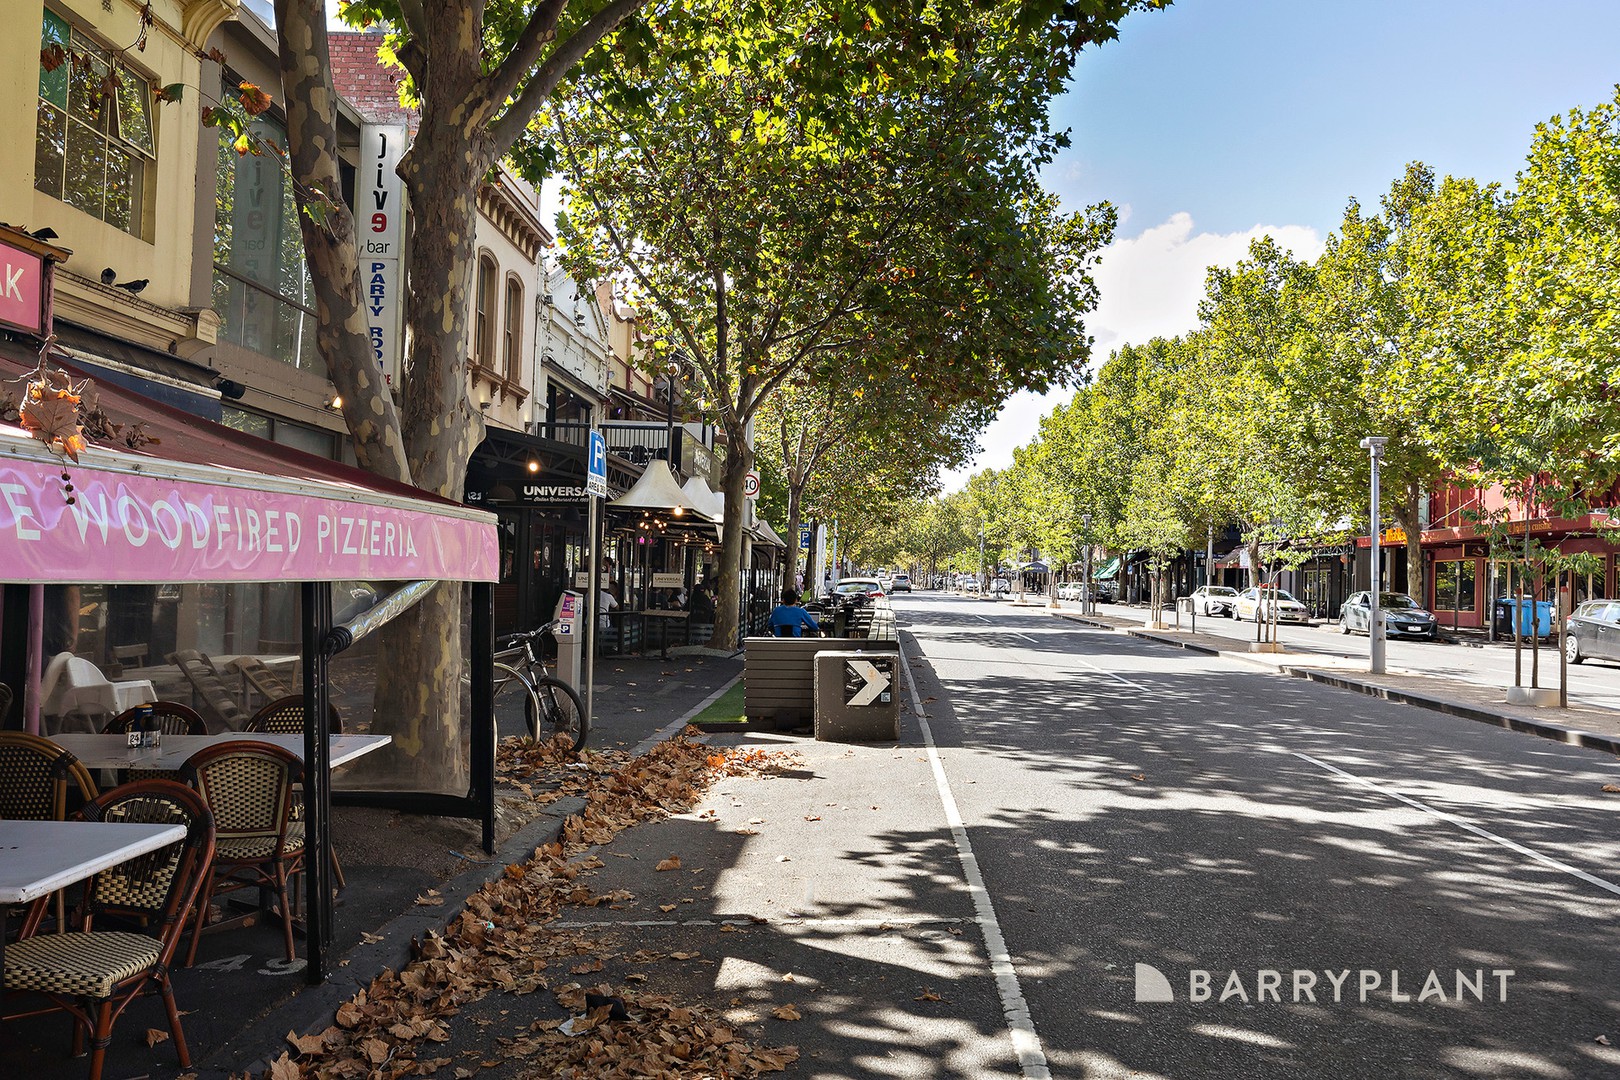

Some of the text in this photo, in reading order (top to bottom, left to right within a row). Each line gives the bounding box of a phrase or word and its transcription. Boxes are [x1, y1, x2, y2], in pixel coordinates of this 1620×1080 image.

[366, 239, 391, 254] bar
[369, 262, 386, 370] PARTY ROO
[593, 440, 604, 469] P
[59, 487, 301, 554] WOODFIRED
[317, 514, 418, 558] PIZZERIA
[802, 532, 810, 541] P
[130, 734, 140, 743] 24
